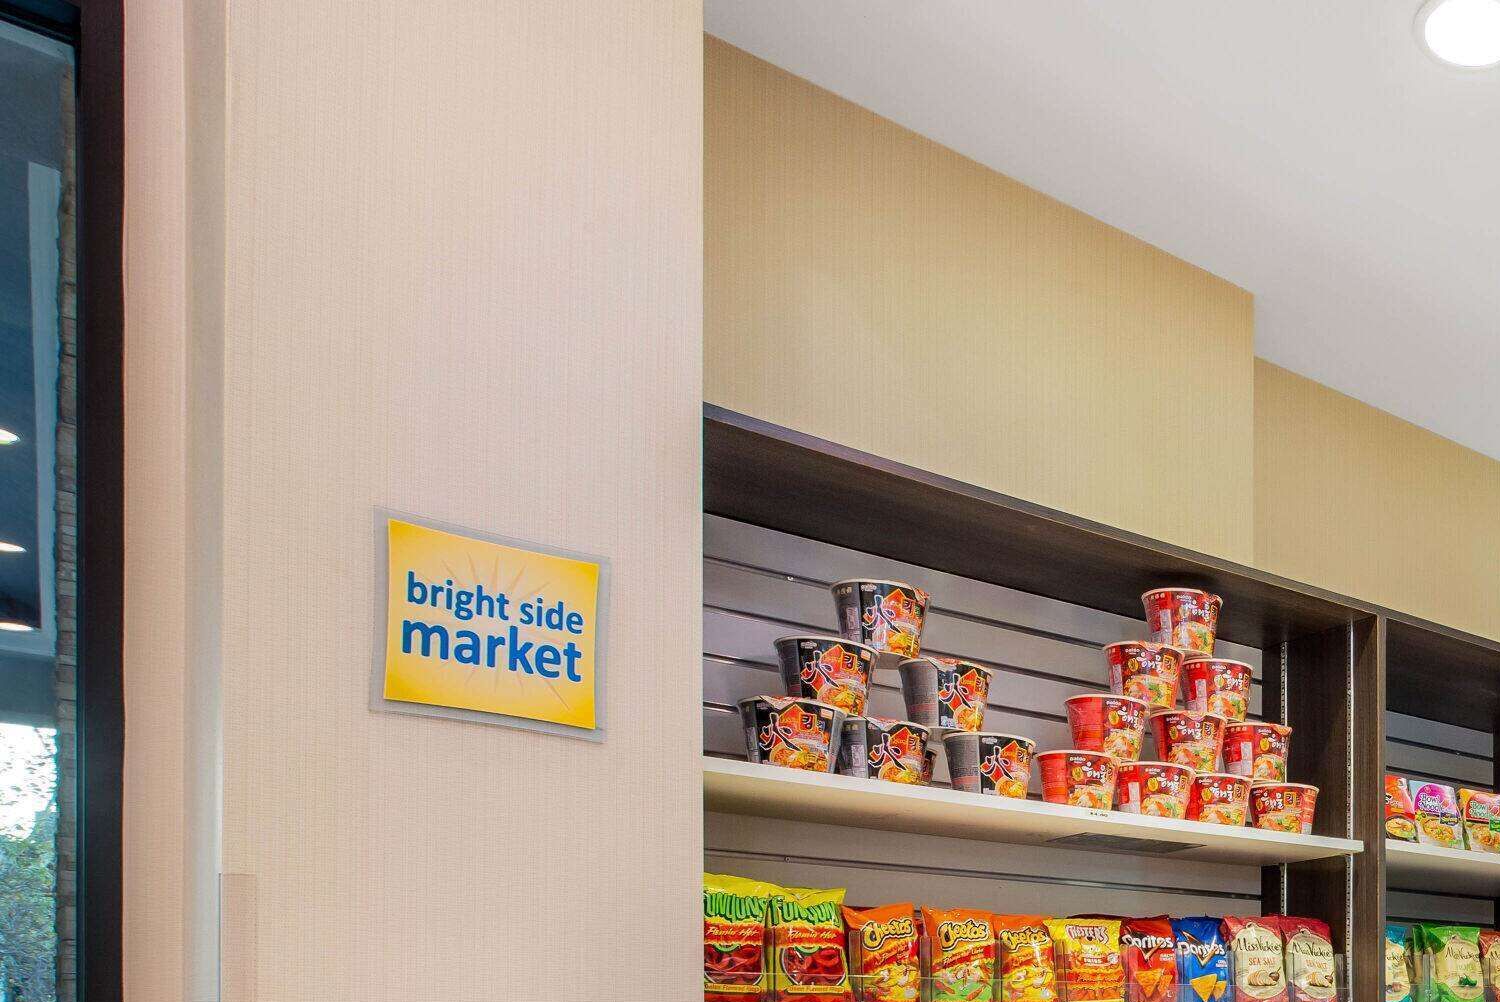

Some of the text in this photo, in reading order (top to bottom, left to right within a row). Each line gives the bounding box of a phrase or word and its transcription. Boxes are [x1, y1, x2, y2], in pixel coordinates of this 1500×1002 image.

[407, 571, 583, 634] bright side
[402, 620, 581, 682] market
[1122, 934, 1174, 949] Doritos
[1176, 941, 1226, 956] Doritos
